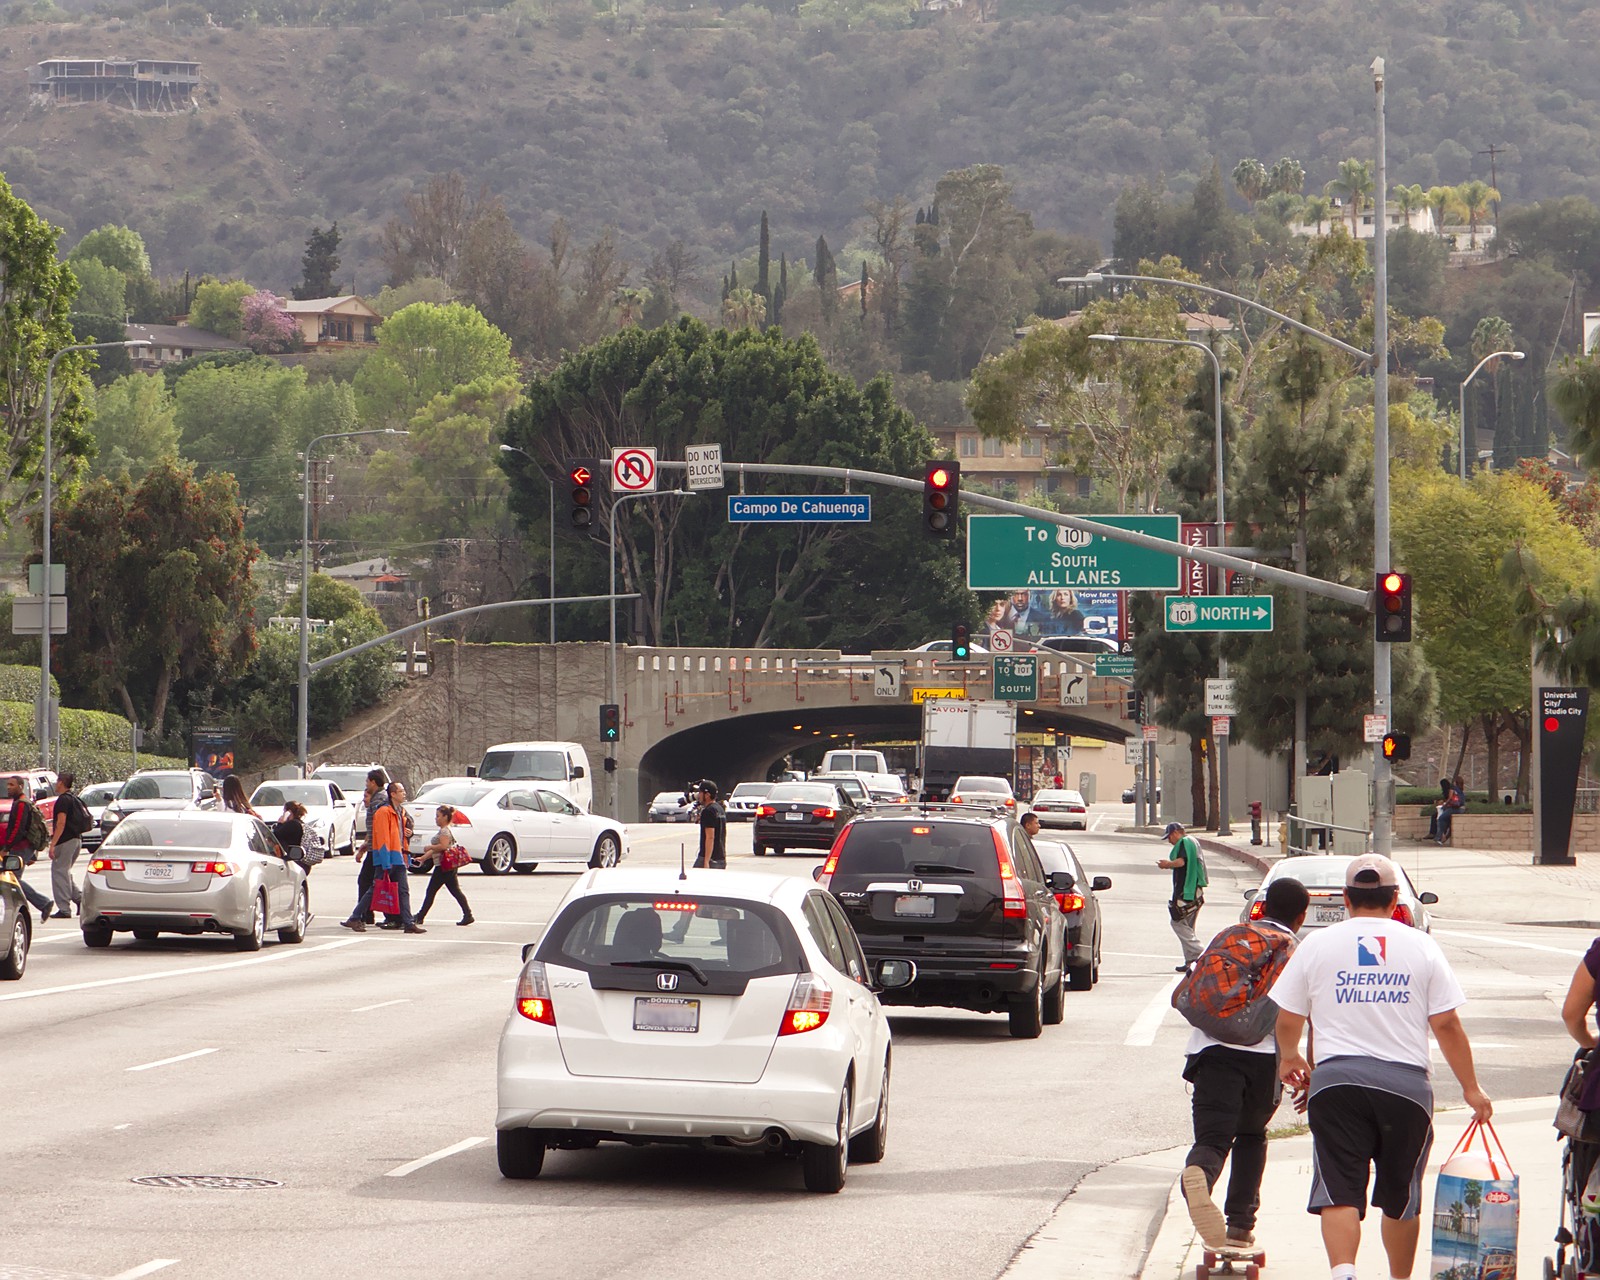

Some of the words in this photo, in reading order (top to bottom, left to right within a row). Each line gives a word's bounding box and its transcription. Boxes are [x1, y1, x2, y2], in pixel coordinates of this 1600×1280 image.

[688, 451, 699, 462] DO
[703, 450, 719, 461] NOT
[689, 464, 721, 476] BLOCK
[690, 476, 722, 486] INTERSECTION
[734, 502, 778, 516] Campo
[781, 502, 798, 513] De
[802, 501, 865, 517] Cahuenga
[1064, 528, 1085, 543] 101
[1192, 527, 1205, 596] HARMNY
[1027, 570, 1059, 585] ALL
[1066, 570, 1121, 585] LANES
[1176, 610, 1192, 621] 101
[1201, 606, 1250, 621] NORTH
[998, 666, 1010, 674] TO
[1017, 666, 1029, 674] 101
[876, 687, 897, 696] ONLY
[1000, 685, 1031, 693] SOUTH
[1063, 695, 1085, 705] ONLY
[1544, 699, 1561, 708] City/
[1568, 708, 1582, 716] City
[1336, 970, 1411, 987] SHERWIN
[1335, 988, 1411, 1004] WILLIAMS
